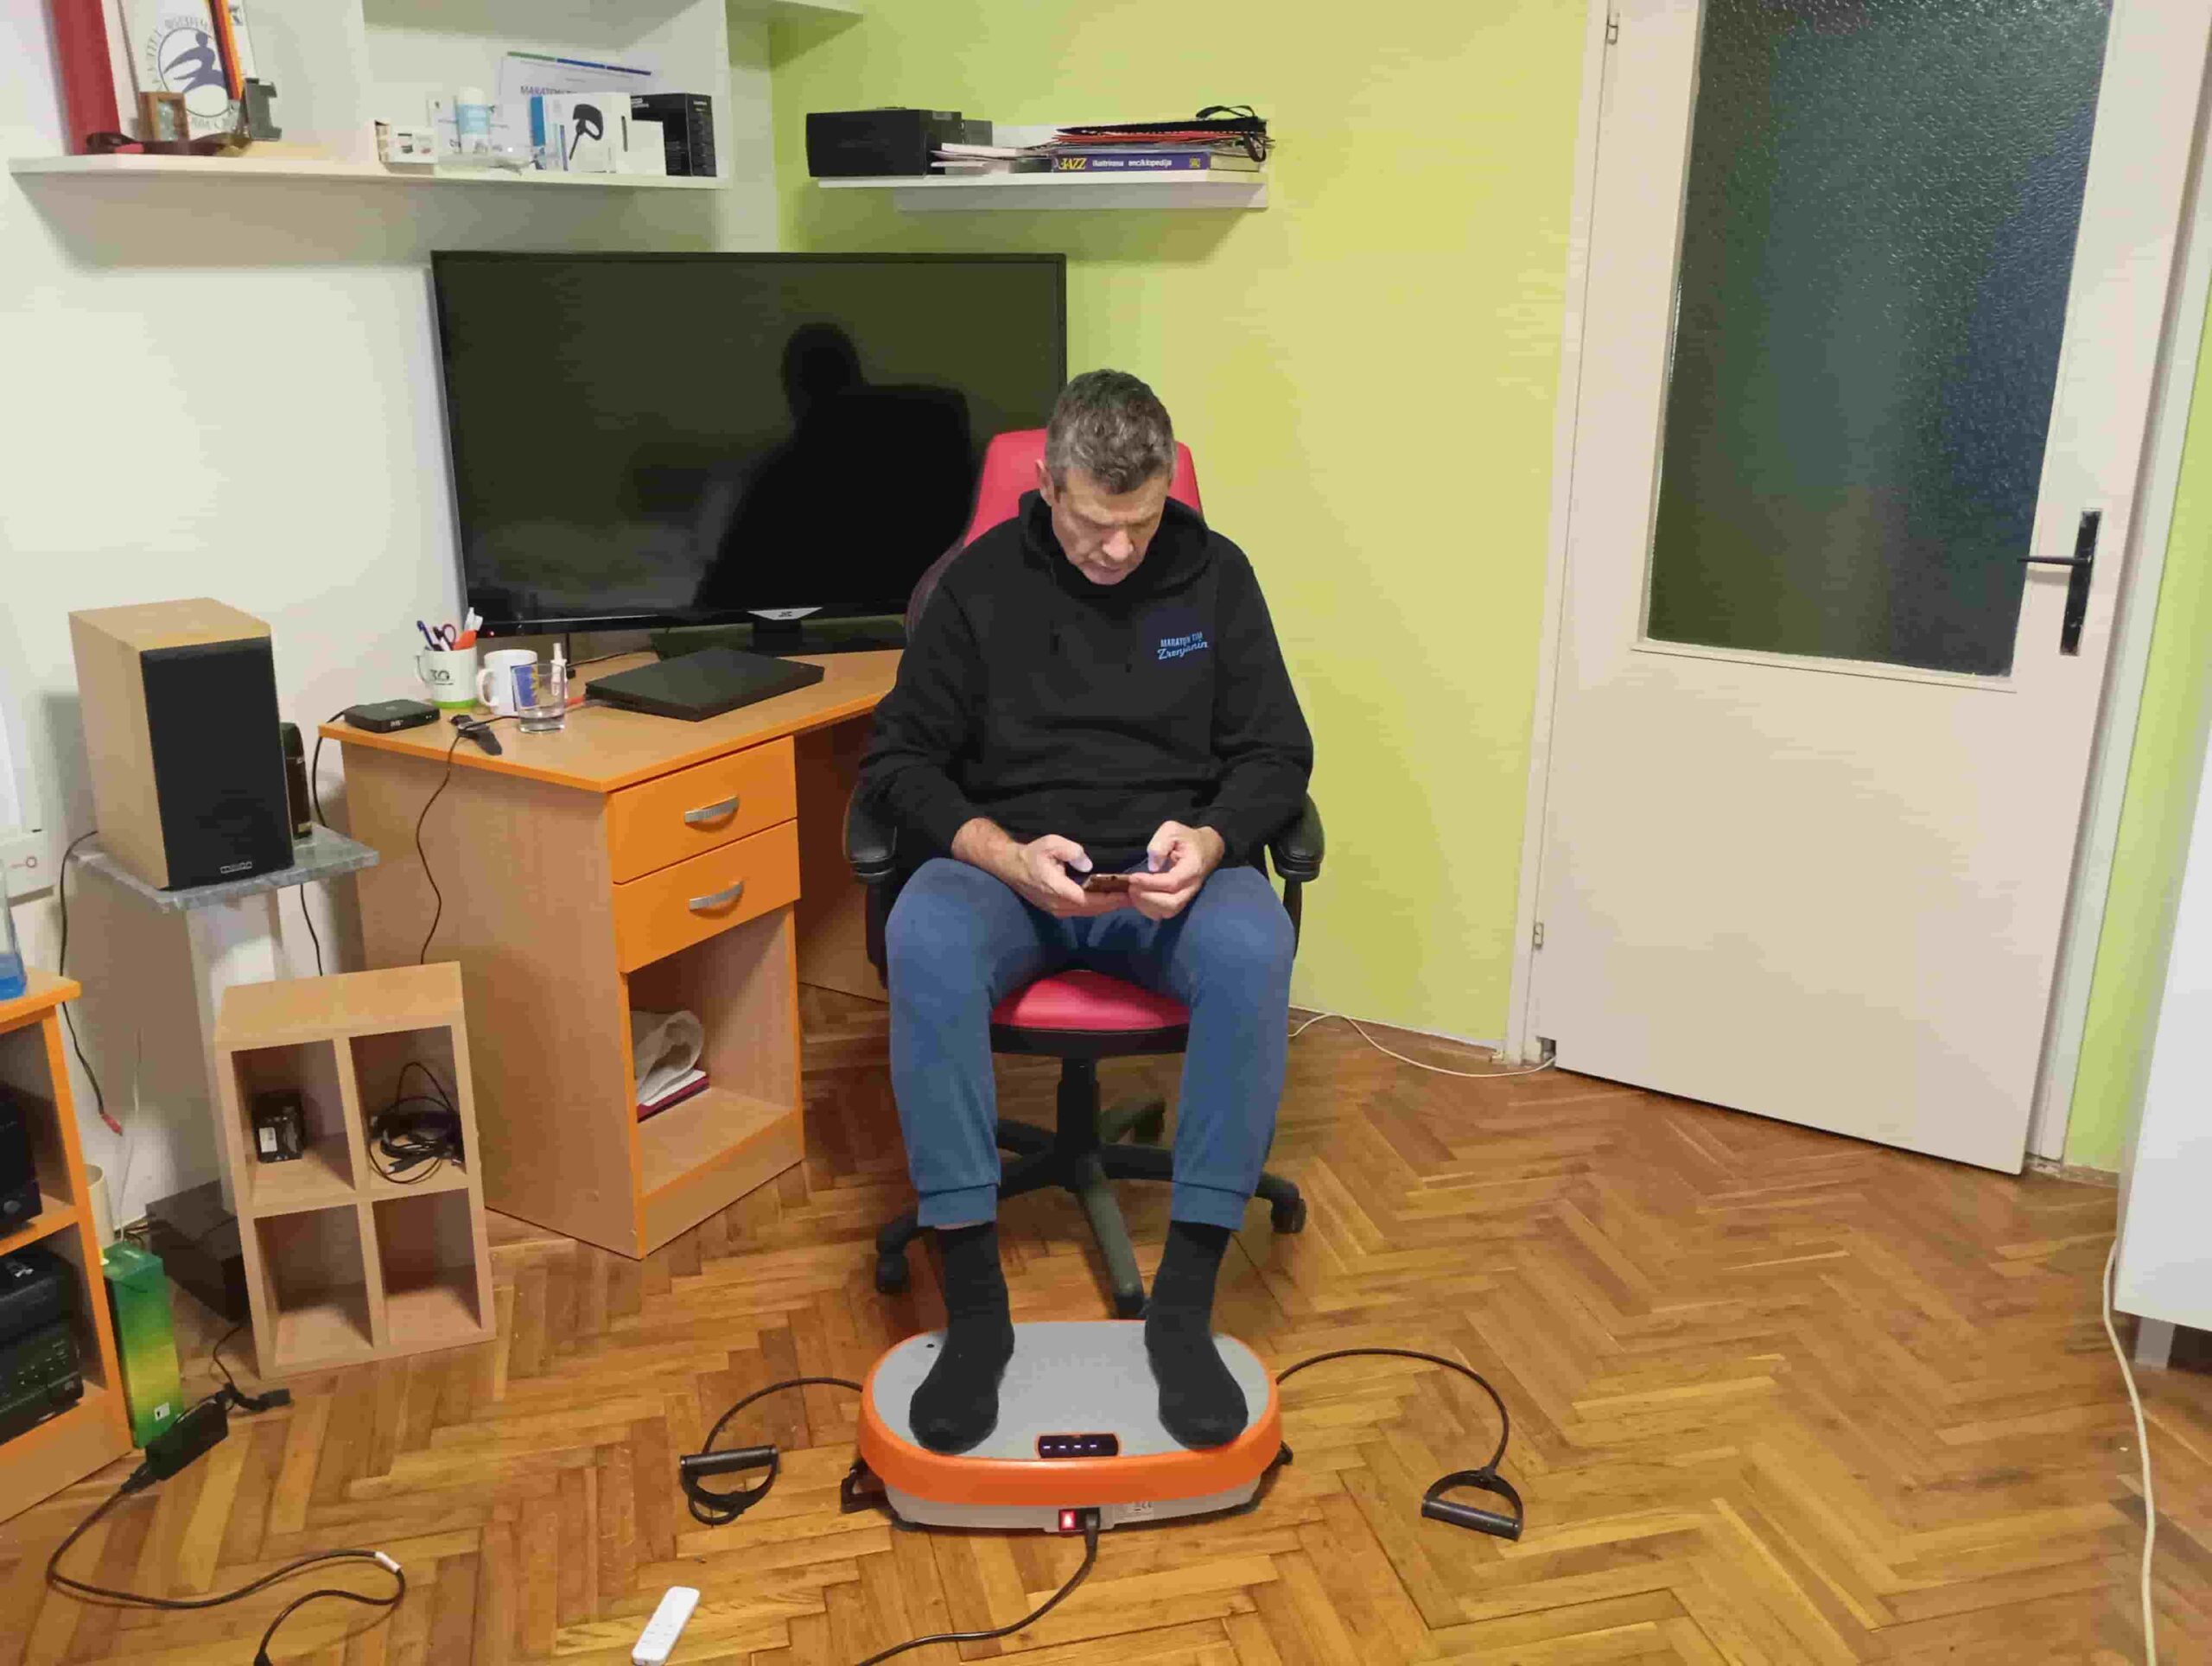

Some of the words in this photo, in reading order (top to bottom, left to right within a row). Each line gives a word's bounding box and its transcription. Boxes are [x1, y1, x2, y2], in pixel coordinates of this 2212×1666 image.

[1058, 157, 1087, 170] JAZZ
[1128, 159, 1173, 168] enciklopedija
[1160, 636, 1191, 647] MARATON
[1157, 639, 1208, 659] Zrenjanin
